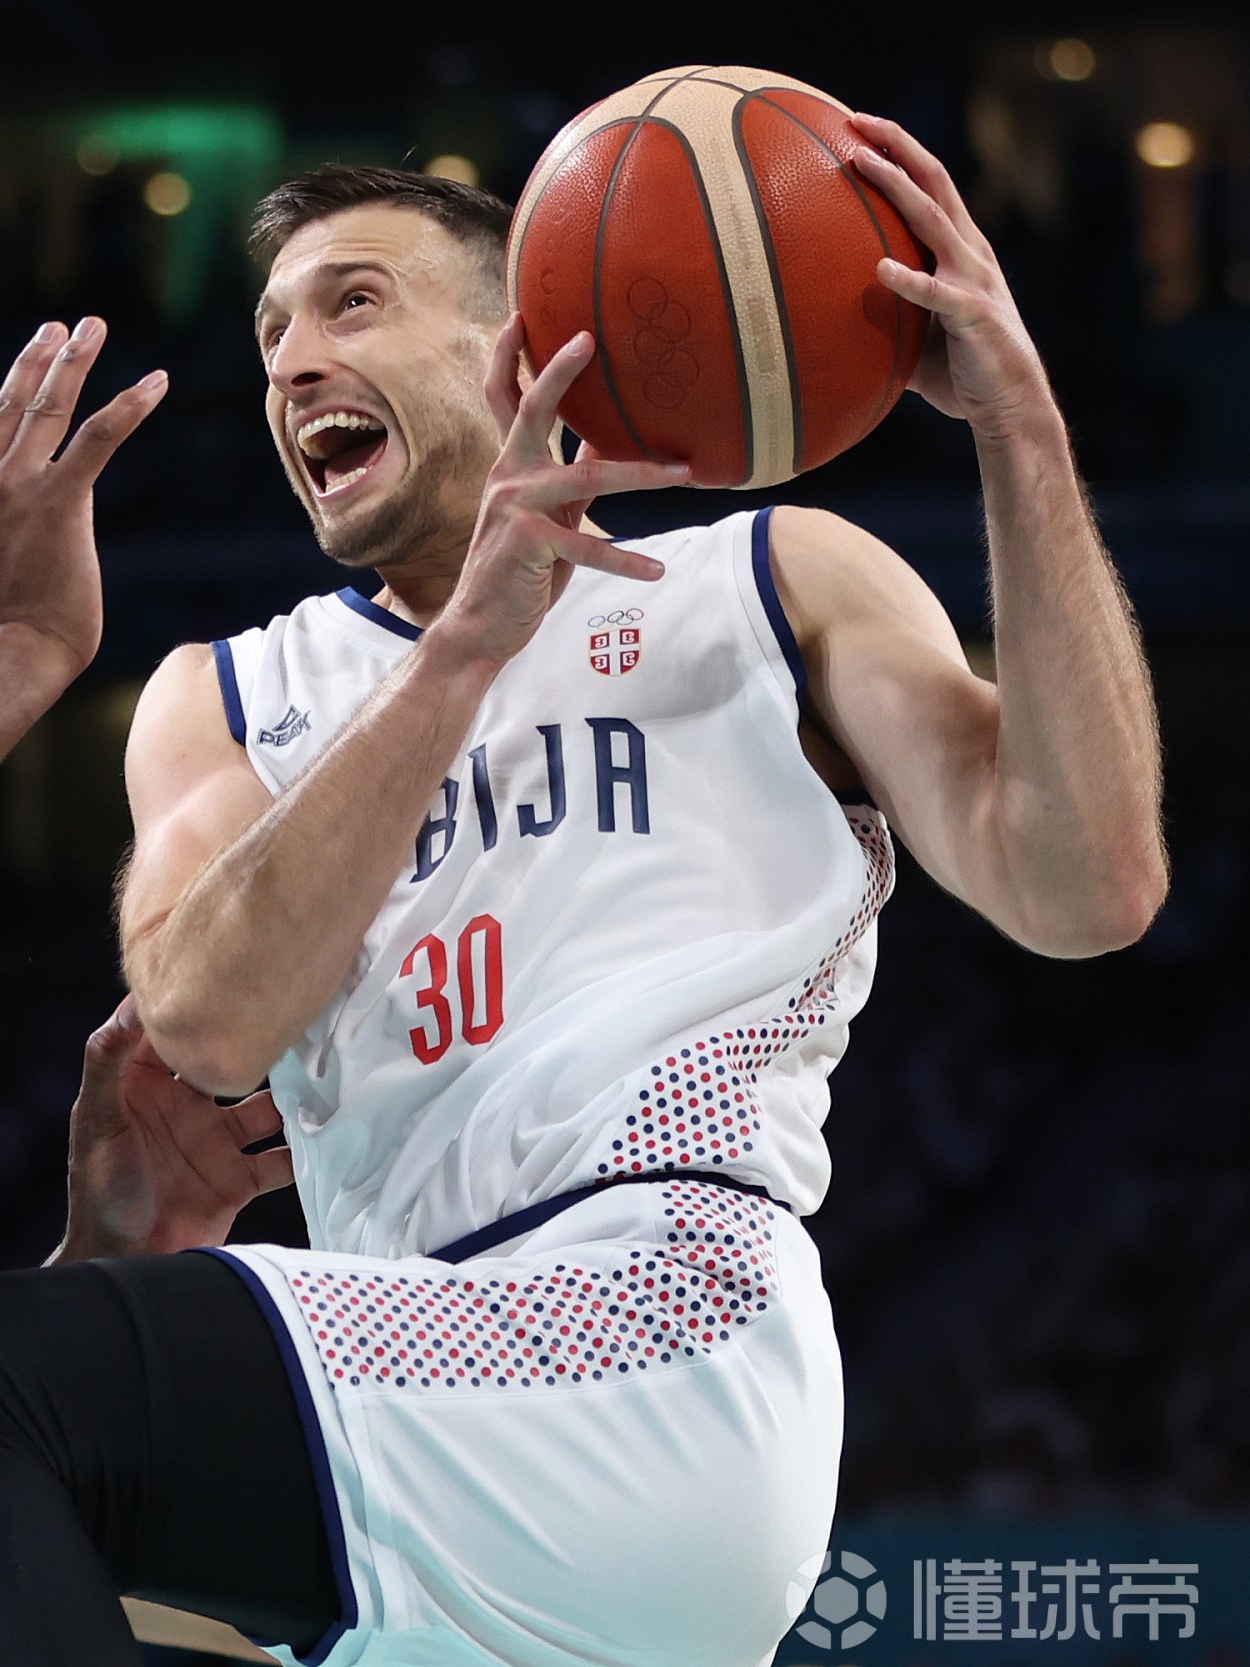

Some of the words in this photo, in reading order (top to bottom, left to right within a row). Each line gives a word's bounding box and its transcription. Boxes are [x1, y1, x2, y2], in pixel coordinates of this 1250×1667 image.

[256, 709, 312, 747] PEAK
[409, 717, 651, 884] BIJA
[398, 913, 504, 1066] 30
